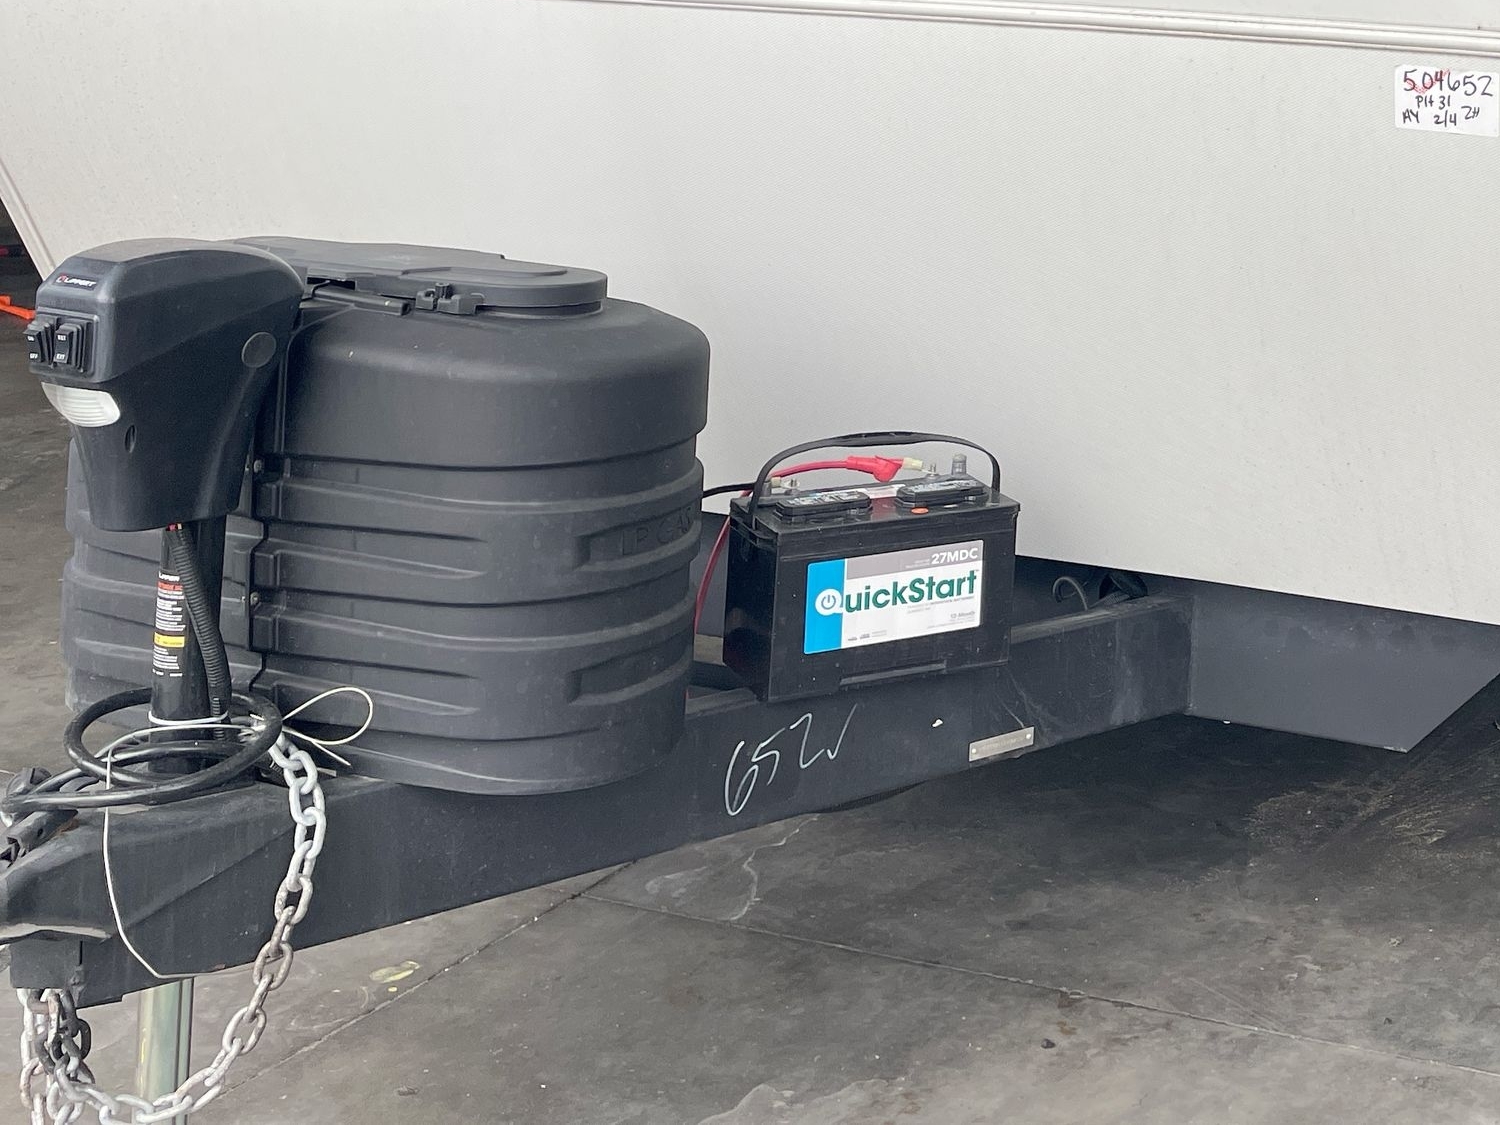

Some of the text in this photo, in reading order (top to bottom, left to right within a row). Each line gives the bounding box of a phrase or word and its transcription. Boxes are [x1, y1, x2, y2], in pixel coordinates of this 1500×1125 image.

[1403, 68, 1494, 96] 504652
[931, 548, 978, 564] 27MDC
[815, 569, 977, 616] QuickStart
